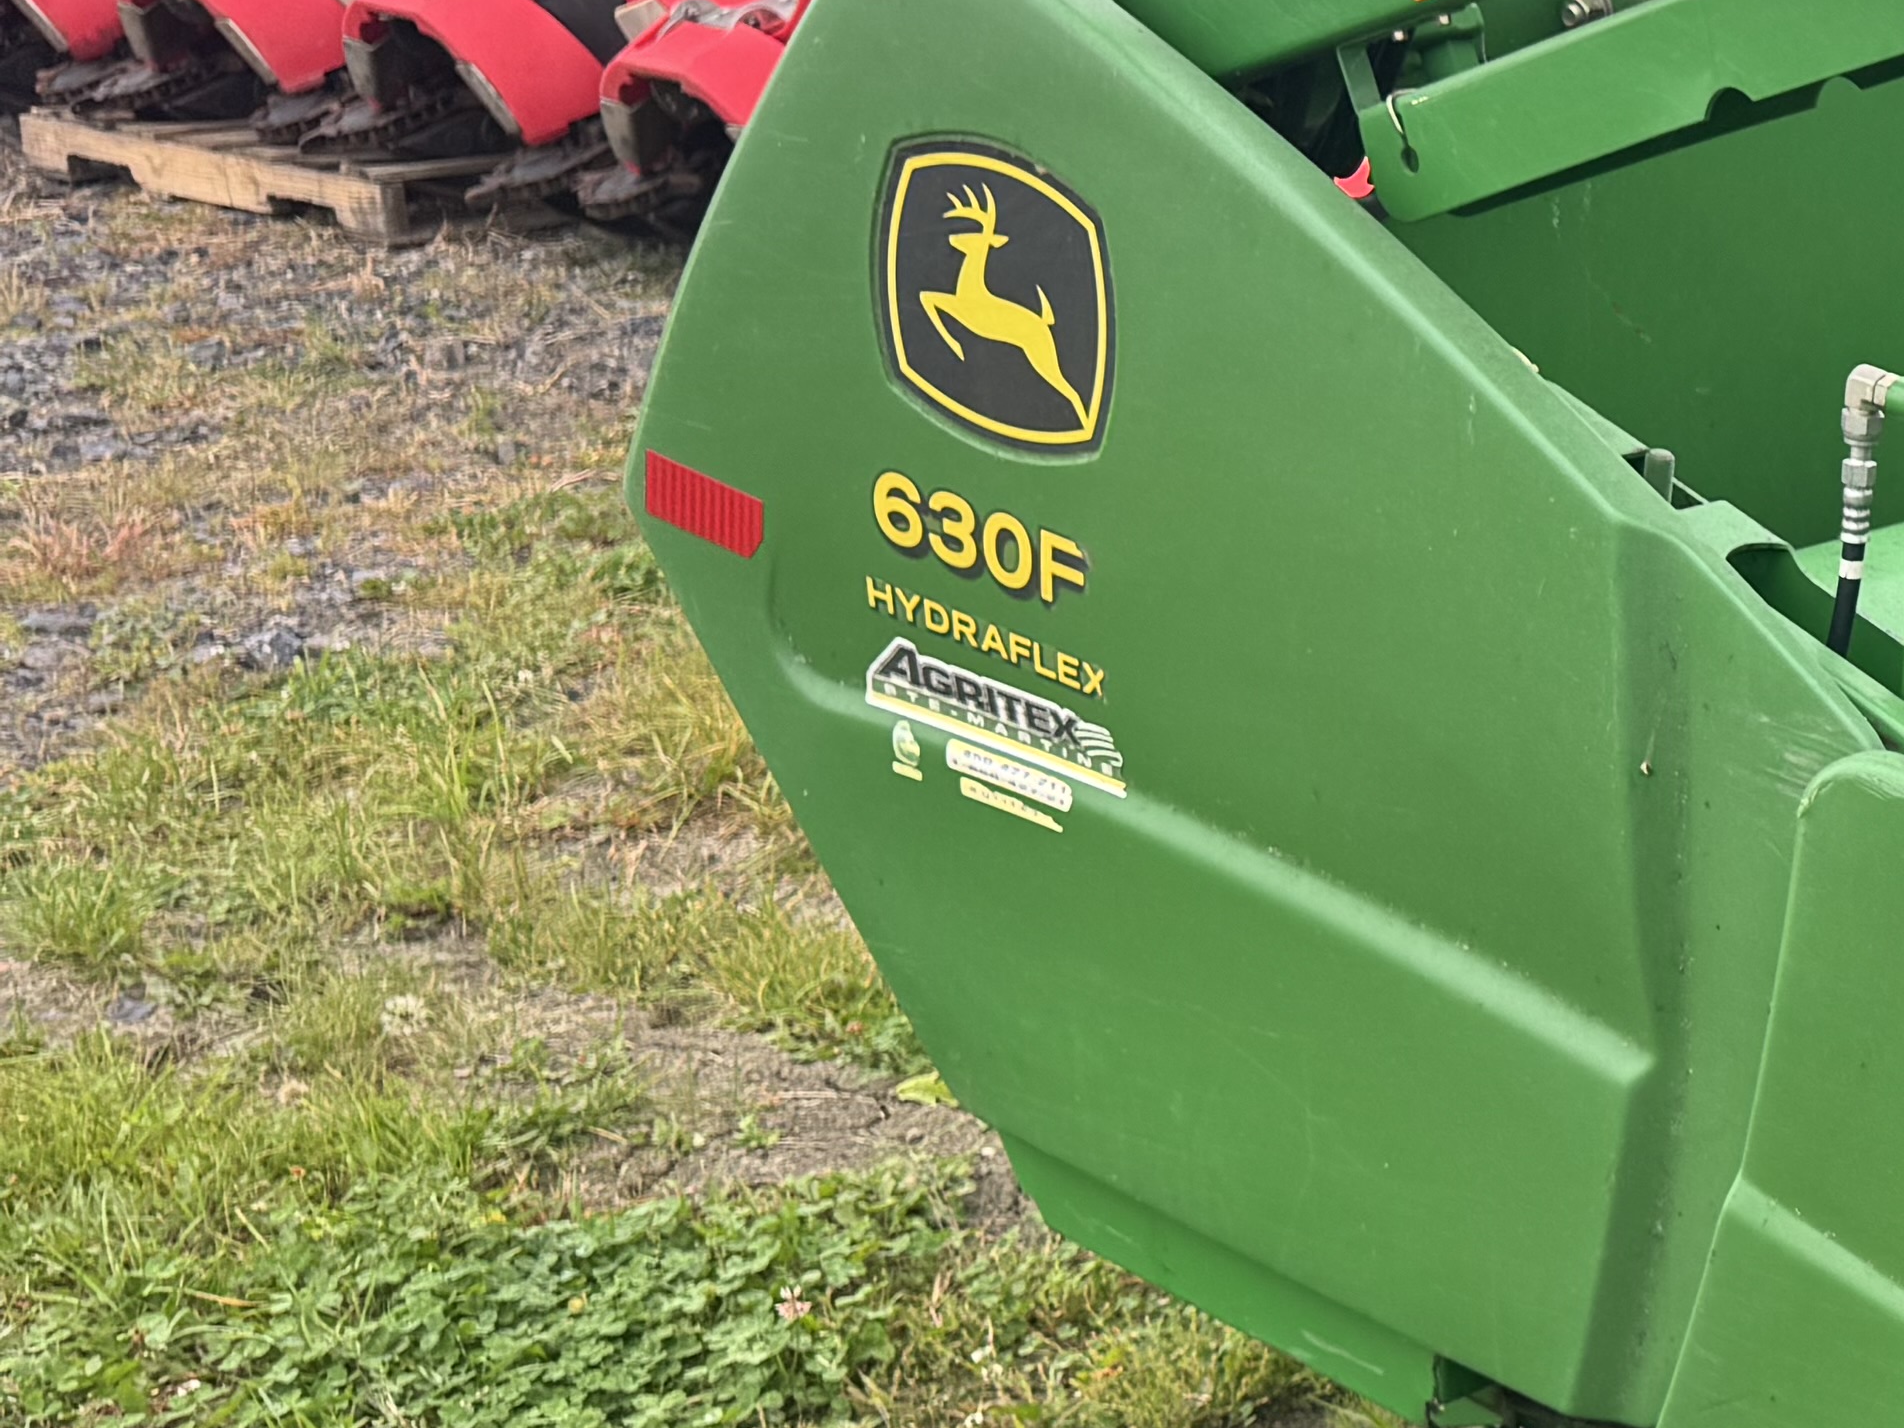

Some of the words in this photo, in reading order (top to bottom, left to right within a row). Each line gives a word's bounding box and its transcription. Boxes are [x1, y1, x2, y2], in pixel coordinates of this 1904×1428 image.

[873, 472, 1086, 604] 630F
[866, 575, 1105, 697] HYDRAFLEX
[878, 645, 1081, 746] AGRITEX
